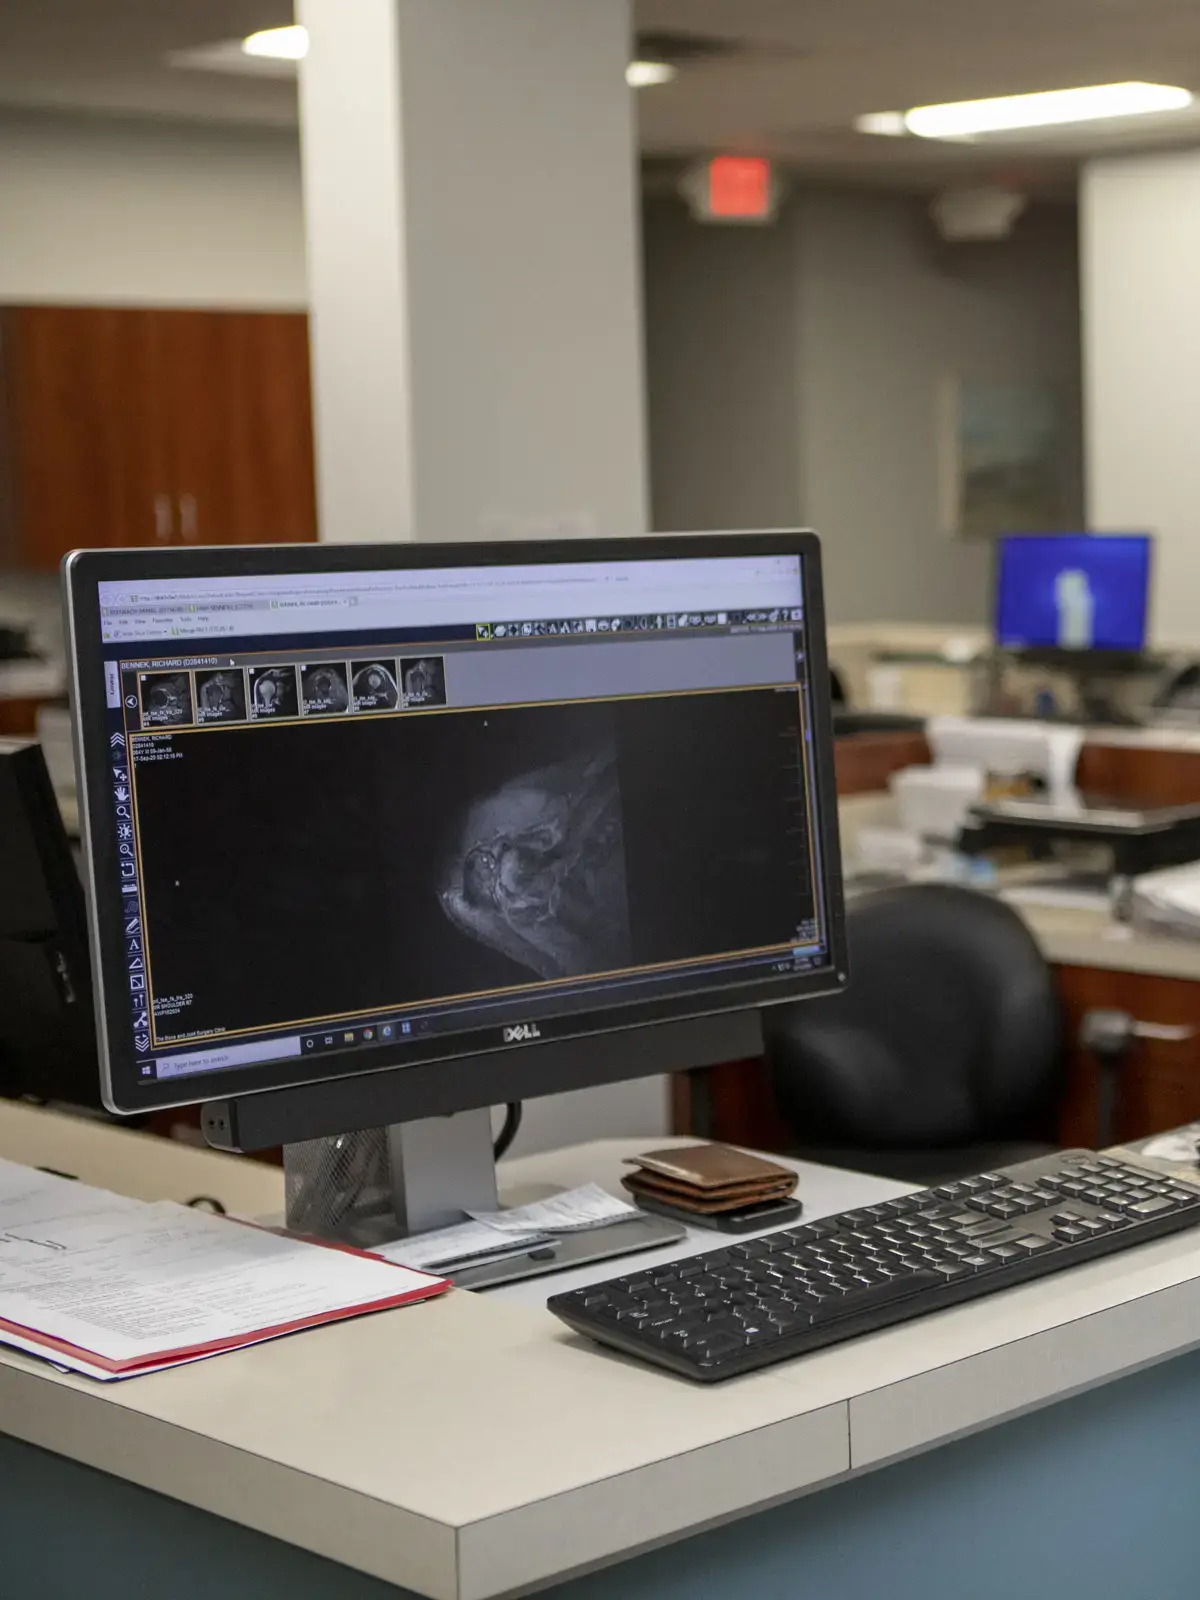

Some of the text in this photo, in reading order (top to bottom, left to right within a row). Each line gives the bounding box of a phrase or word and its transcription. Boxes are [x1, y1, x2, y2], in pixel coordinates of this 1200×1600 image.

[152, 659, 182, 667] RICHARD
[161, 1000, 186, 1009] SHOULDER
[503, 1023, 541, 1042] DELL
[174, 1062, 188, 1070] Type
[210, 1055, 229, 1064] search
